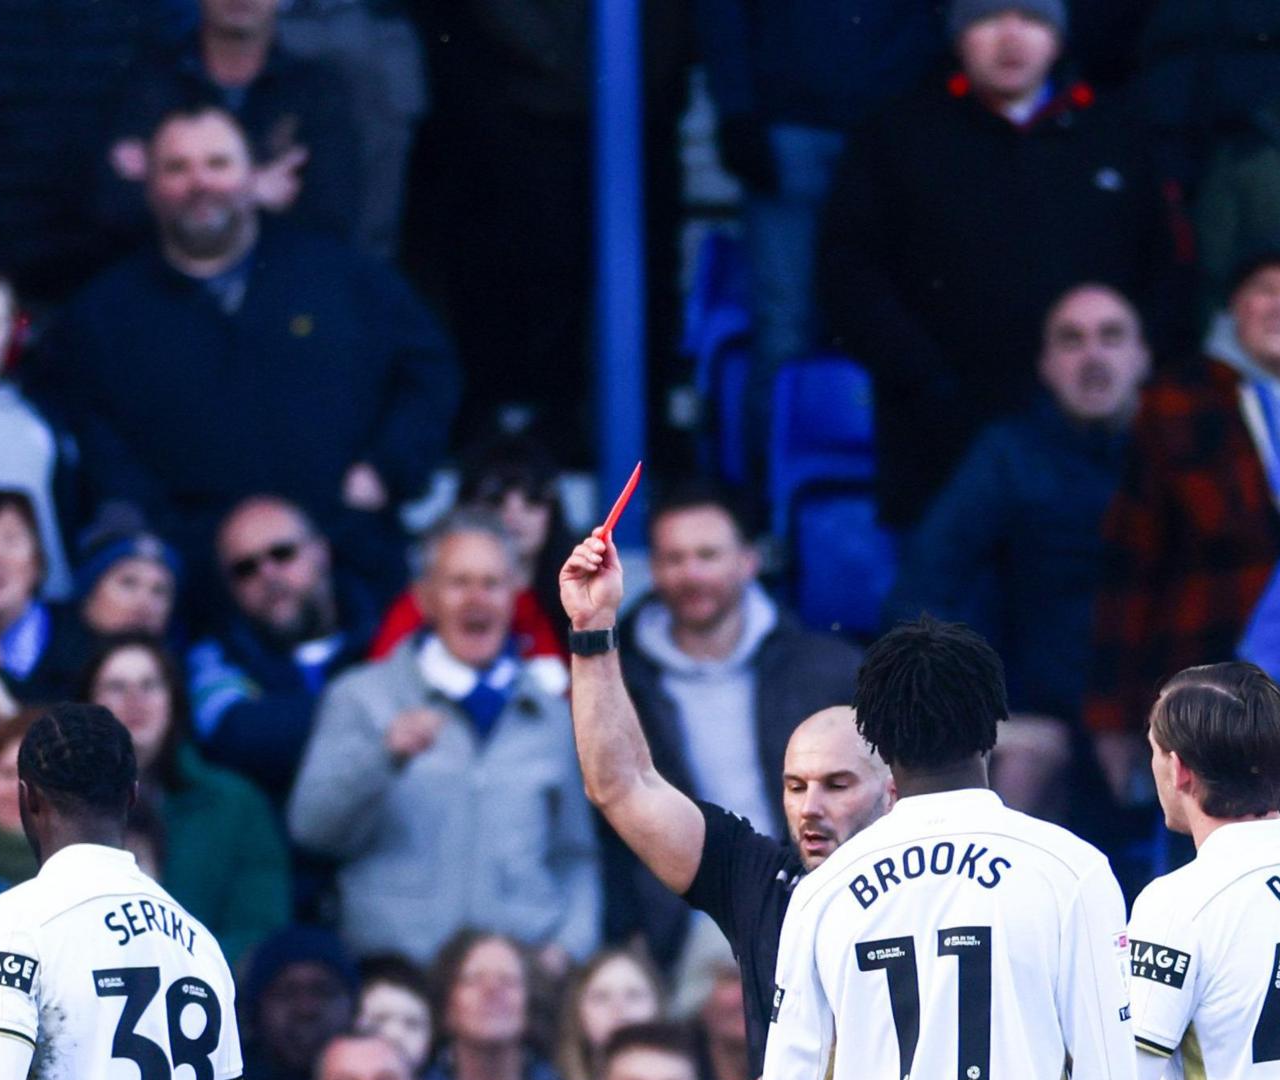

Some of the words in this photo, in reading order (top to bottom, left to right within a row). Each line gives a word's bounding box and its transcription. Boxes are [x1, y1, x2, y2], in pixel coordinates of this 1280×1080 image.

[849, 842, 1012, 910] BROOKS
[104, 900, 197, 955] SERIKI
[1133, 964, 1171, 983] TELS
